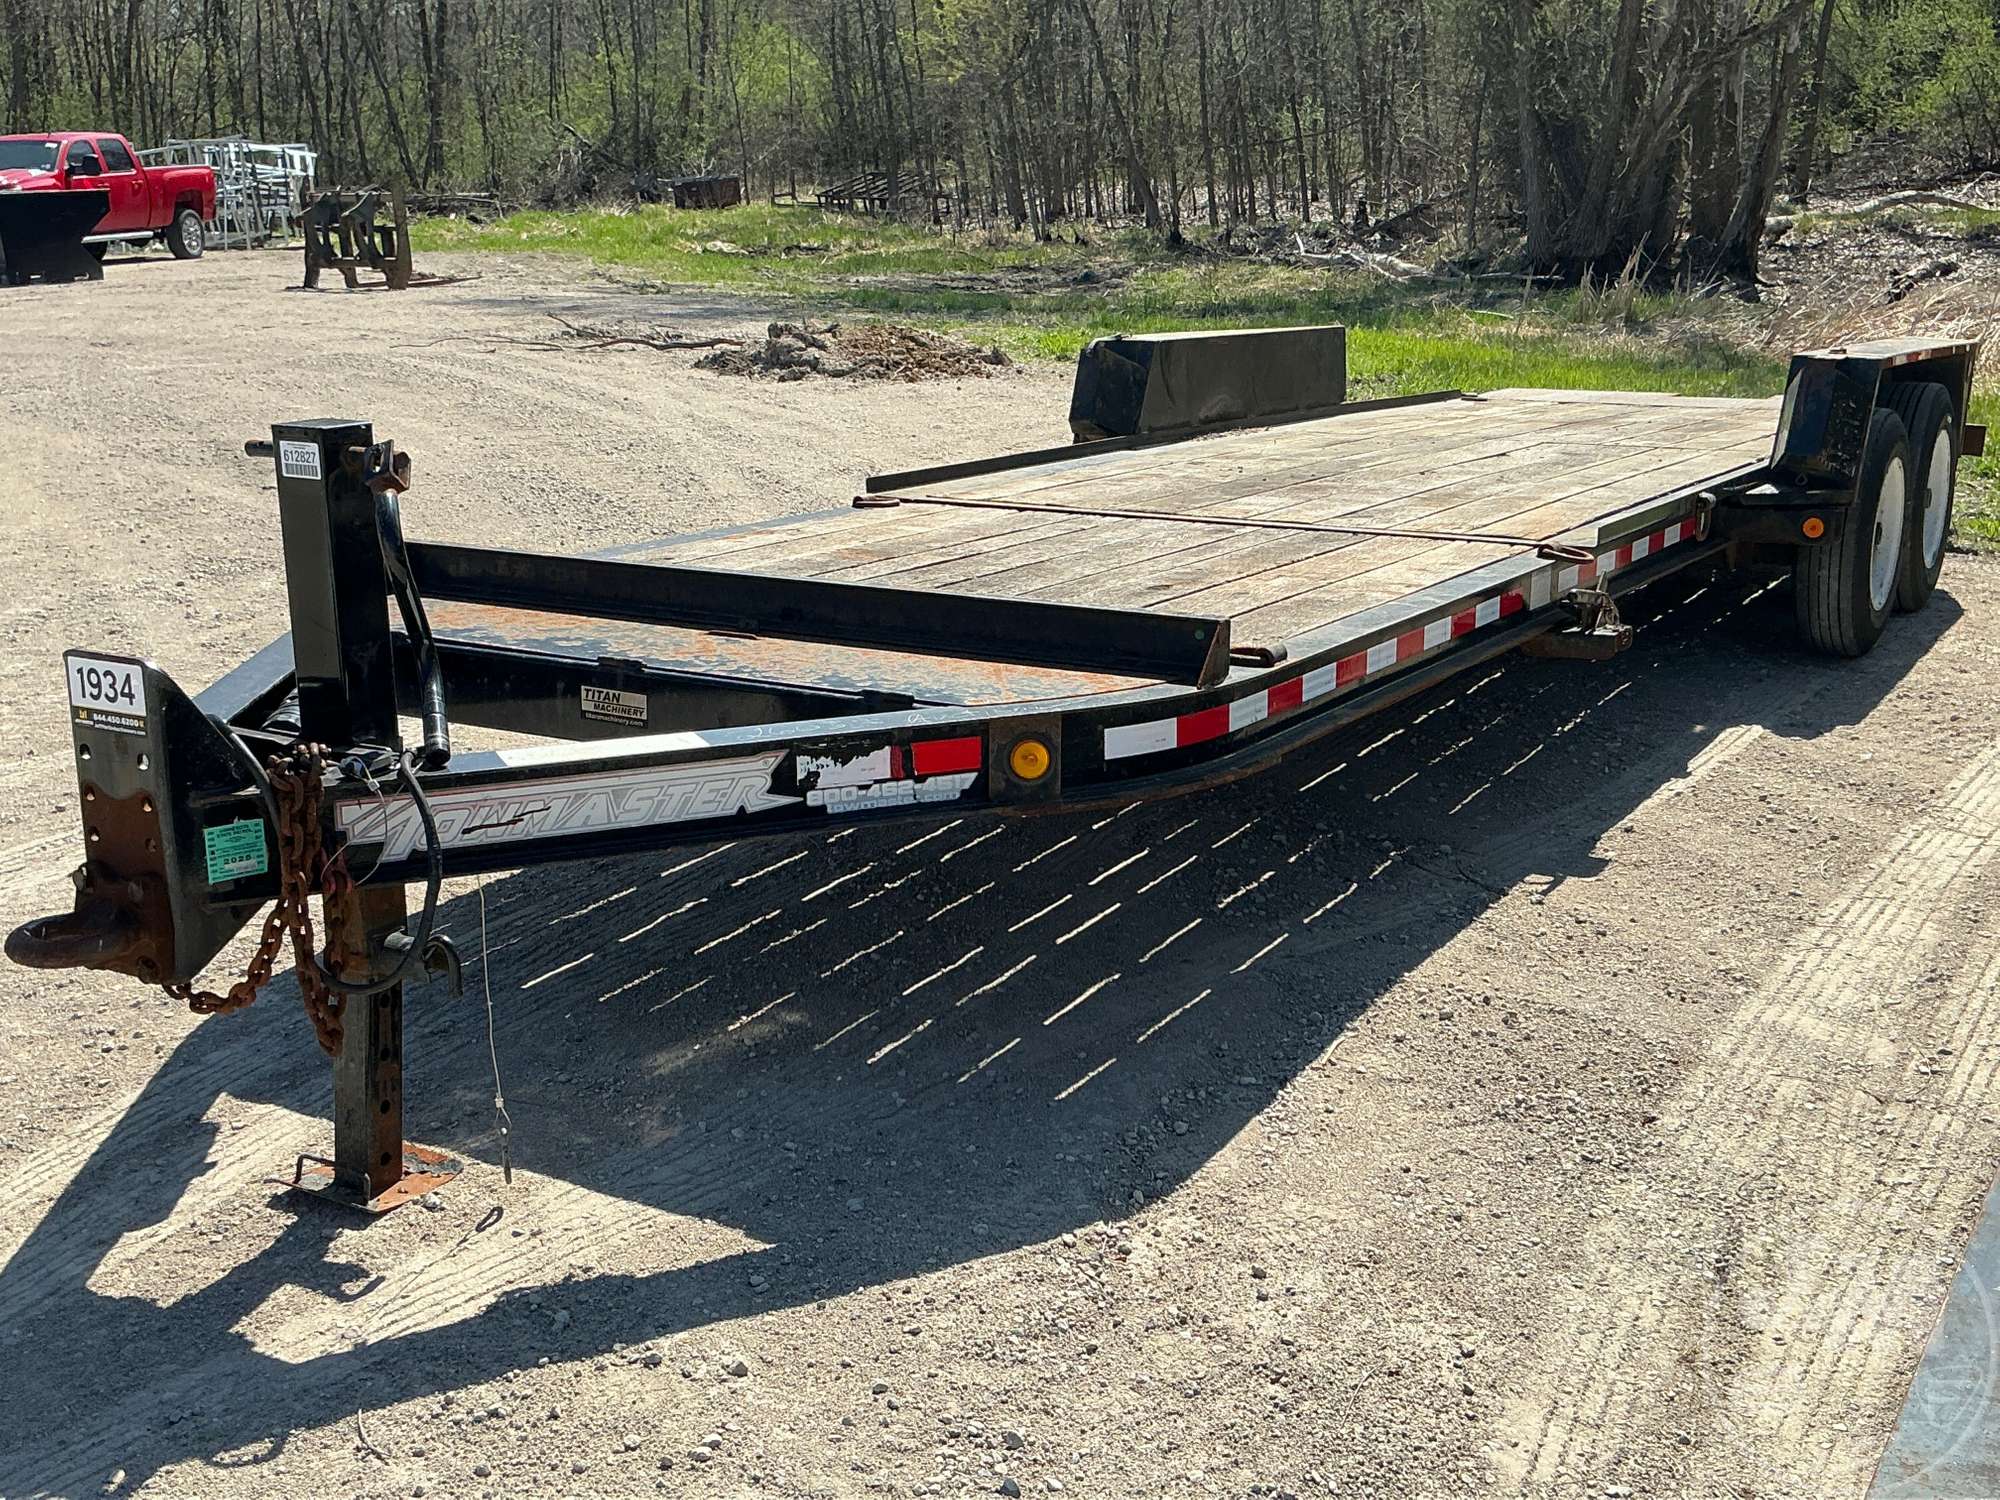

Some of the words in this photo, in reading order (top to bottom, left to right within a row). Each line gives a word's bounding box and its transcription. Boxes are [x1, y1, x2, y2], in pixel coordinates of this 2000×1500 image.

[283, 449, 316, 464] 612827
[76, 666, 136, 706] 1934
[584, 688, 621, 703] TITAN
[593, 703, 644, 717] MACHINERY
